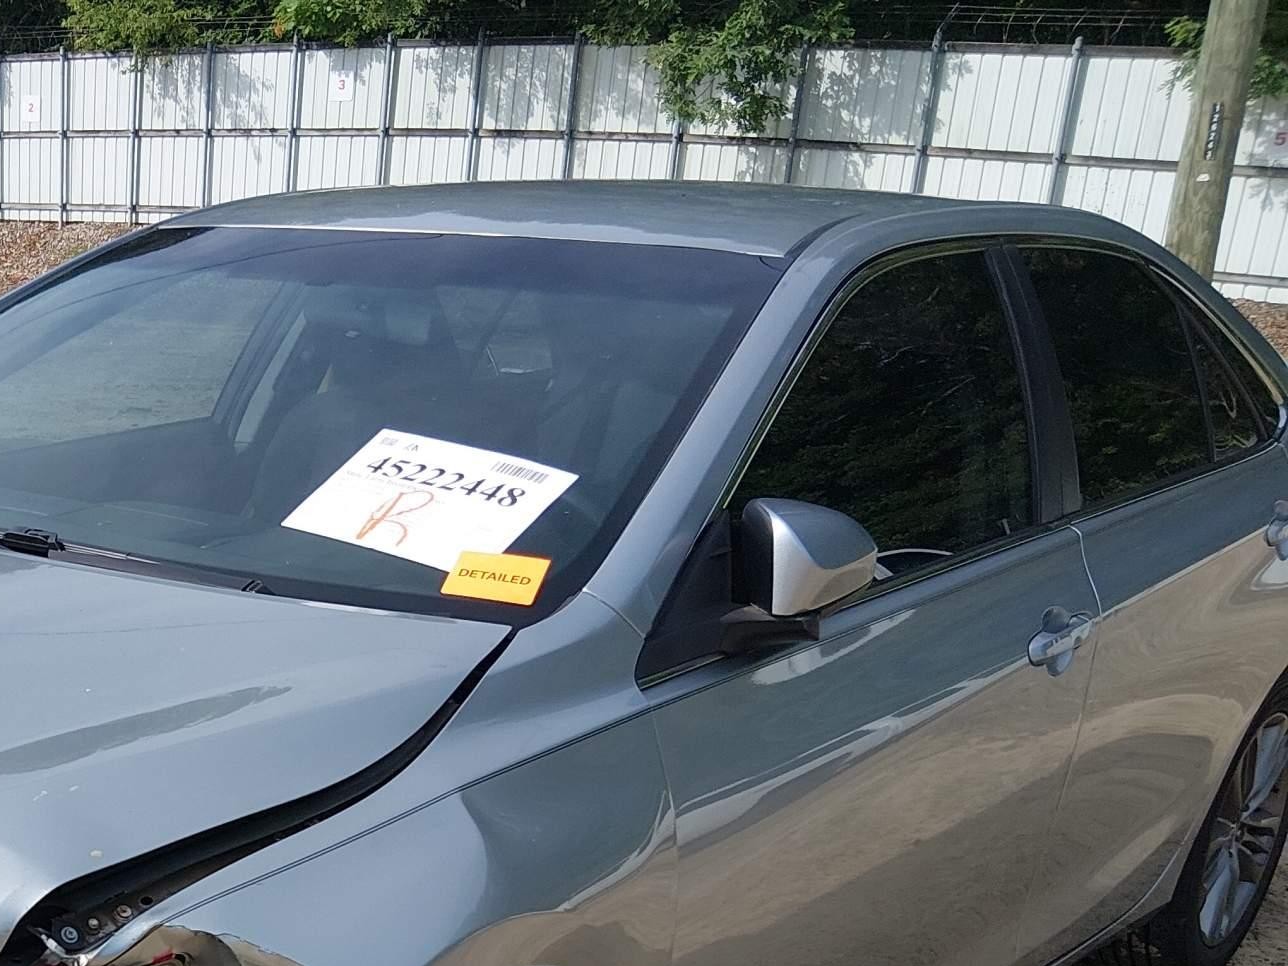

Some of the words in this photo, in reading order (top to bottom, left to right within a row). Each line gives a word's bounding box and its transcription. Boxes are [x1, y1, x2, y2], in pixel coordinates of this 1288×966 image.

[337, 79, 345, 90] 3
[28, 103, 34, 112] 2
[1273, 131, 1288, 146] 5
[367, 456, 526, 507] 45222448
[458, 568, 532, 586] DETAILED
